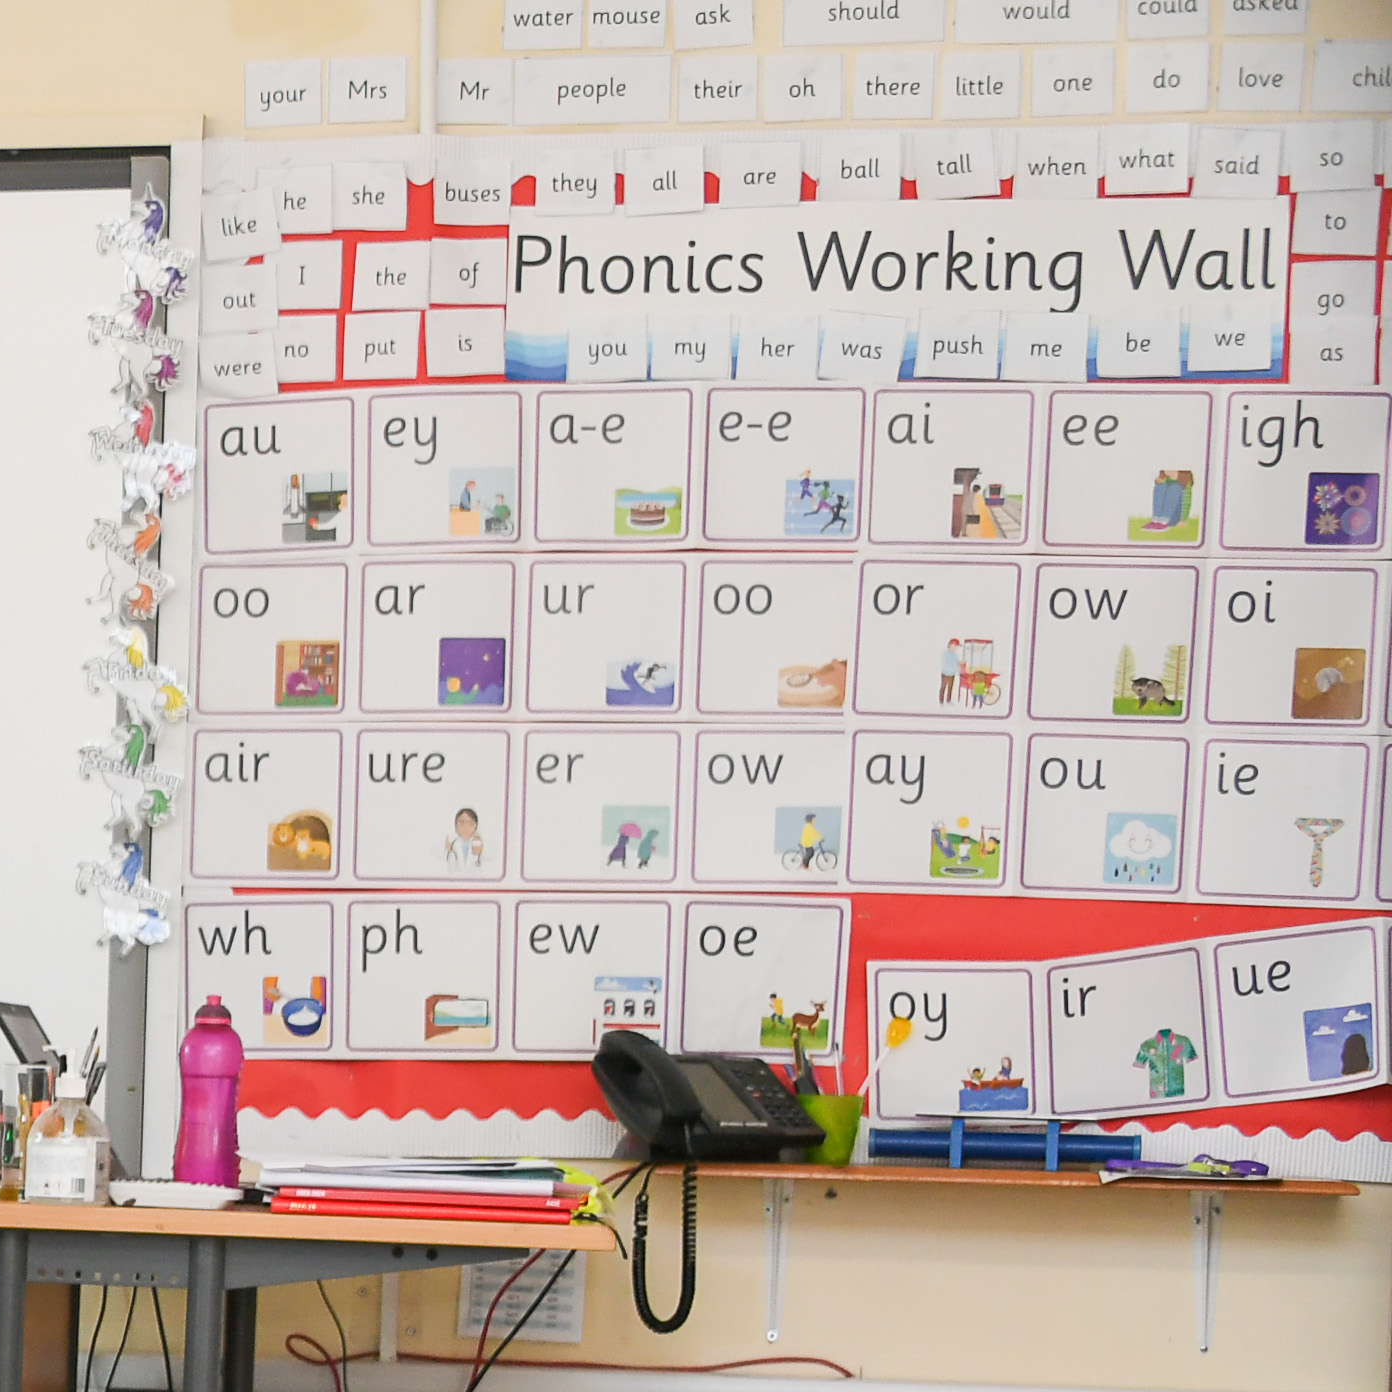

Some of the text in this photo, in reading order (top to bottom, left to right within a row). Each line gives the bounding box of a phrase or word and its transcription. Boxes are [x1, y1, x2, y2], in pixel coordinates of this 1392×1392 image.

[513, 11, 574, 27] water
[592, 10, 661, 25] mouse
[695, 3, 731, 26] ask
[828, 0, 900, 22] should
[1002, 0, 1070, 20] would
[1137, 0, 1198, 16] could
[789, 77, 816, 98] oh
[866, 75, 921, 96] there
[956, 75, 1004, 96] little
[1053, 77, 1093, 93] one
[1153, 68, 1181, 89] do
[1238, 66, 1284, 88] love
[260, 88, 307, 112] your
[348, 80, 387, 99] Mrs
[460, 81, 490, 100] Mr
[557, 76, 626, 106] people
[694, 79, 743, 100] their
[841, 157, 880, 180] ball
[937, 153, 972, 176] tall
[1027, 155, 1087, 176] when
[1119, 148, 1175, 169] what
[1214, 154, 1259, 175] said
[1319, 151, 1344, 167] so
[552, 172, 597, 199] they
[652, 170, 678, 191] all
[743, 171, 777, 185] are
[283, 191, 307, 210] he
[352, 185, 385, 205] she
[445, 181, 500, 203] buses
[221, 216, 257, 237] like
[1325, 213, 1347, 231] to
[101, 225, 193, 271] Monday
[299, 265, 305, 286] I
[376, 266, 407, 286] the
[459, 262, 479, 289] of
[515, 227, 1276, 313] Phonics Working Wall
[223, 292, 255, 310] out
[1317, 293, 1345, 316] go
[102, 318, 184, 354] Tuesday
[458, 338, 473, 352] is
[761, 336, 795, 357] her
[932, 334, 984, 361] push
[1126, 332, 1151, 353] be
[1214, 332, 1246, 347] we
[284, 344, 309, 358] no
[364, 339, 395, 363] put
[588, 343, 628, 365] you
[674, 342, 706, 363] my
[841, 342, 882, 360] was
[1030, 343, 1062, 358] me
[1320, 347, 1343, 362] as
[213, 362, 262, 377] were
[549, 413, 625, 444] a-e
[719, 411, 792, 442] e-e
[887, 402, 934, 444] ai
[1062, 414, 1119, 446] ee
[1242, 399, 1324, 468] igh
[220, 425, 281, 456] au
[383, 416, 437, 465] ey
[213, 588, 270, 618] oo
[375, 584, 426, 615] ar
[543, 584, 595, 615] ur
[713, 584, 773, 615] oo
[873, 583, 924, 615] or
[1049, 587, 1128, 621] ow
[1227, 580, 1276, 623] oi
[87, 749, 183, 792] Saturday
[205, 742, 270, 783] air
[368, 752, 445, 783] ure
[536, 753, 584, 784] er
[708, 753, 784, 785] ow
[1040, 757, 1106, 790] ou
[1218, 752, 1259, 796] ie
[865, 754, 925, 805] ay
[89, 866, 170, 912] Sunday
[198, 909, 272, 956] wh
[362, 908, 423, 973] ph
[529, 924, 600, 954] ew
[699, 925, 758, 957] oe
[1232, 960, 1291, 997] ue
[1062, 977, 1097, 1018] ir
[889, 991, 947, 1042] oy
